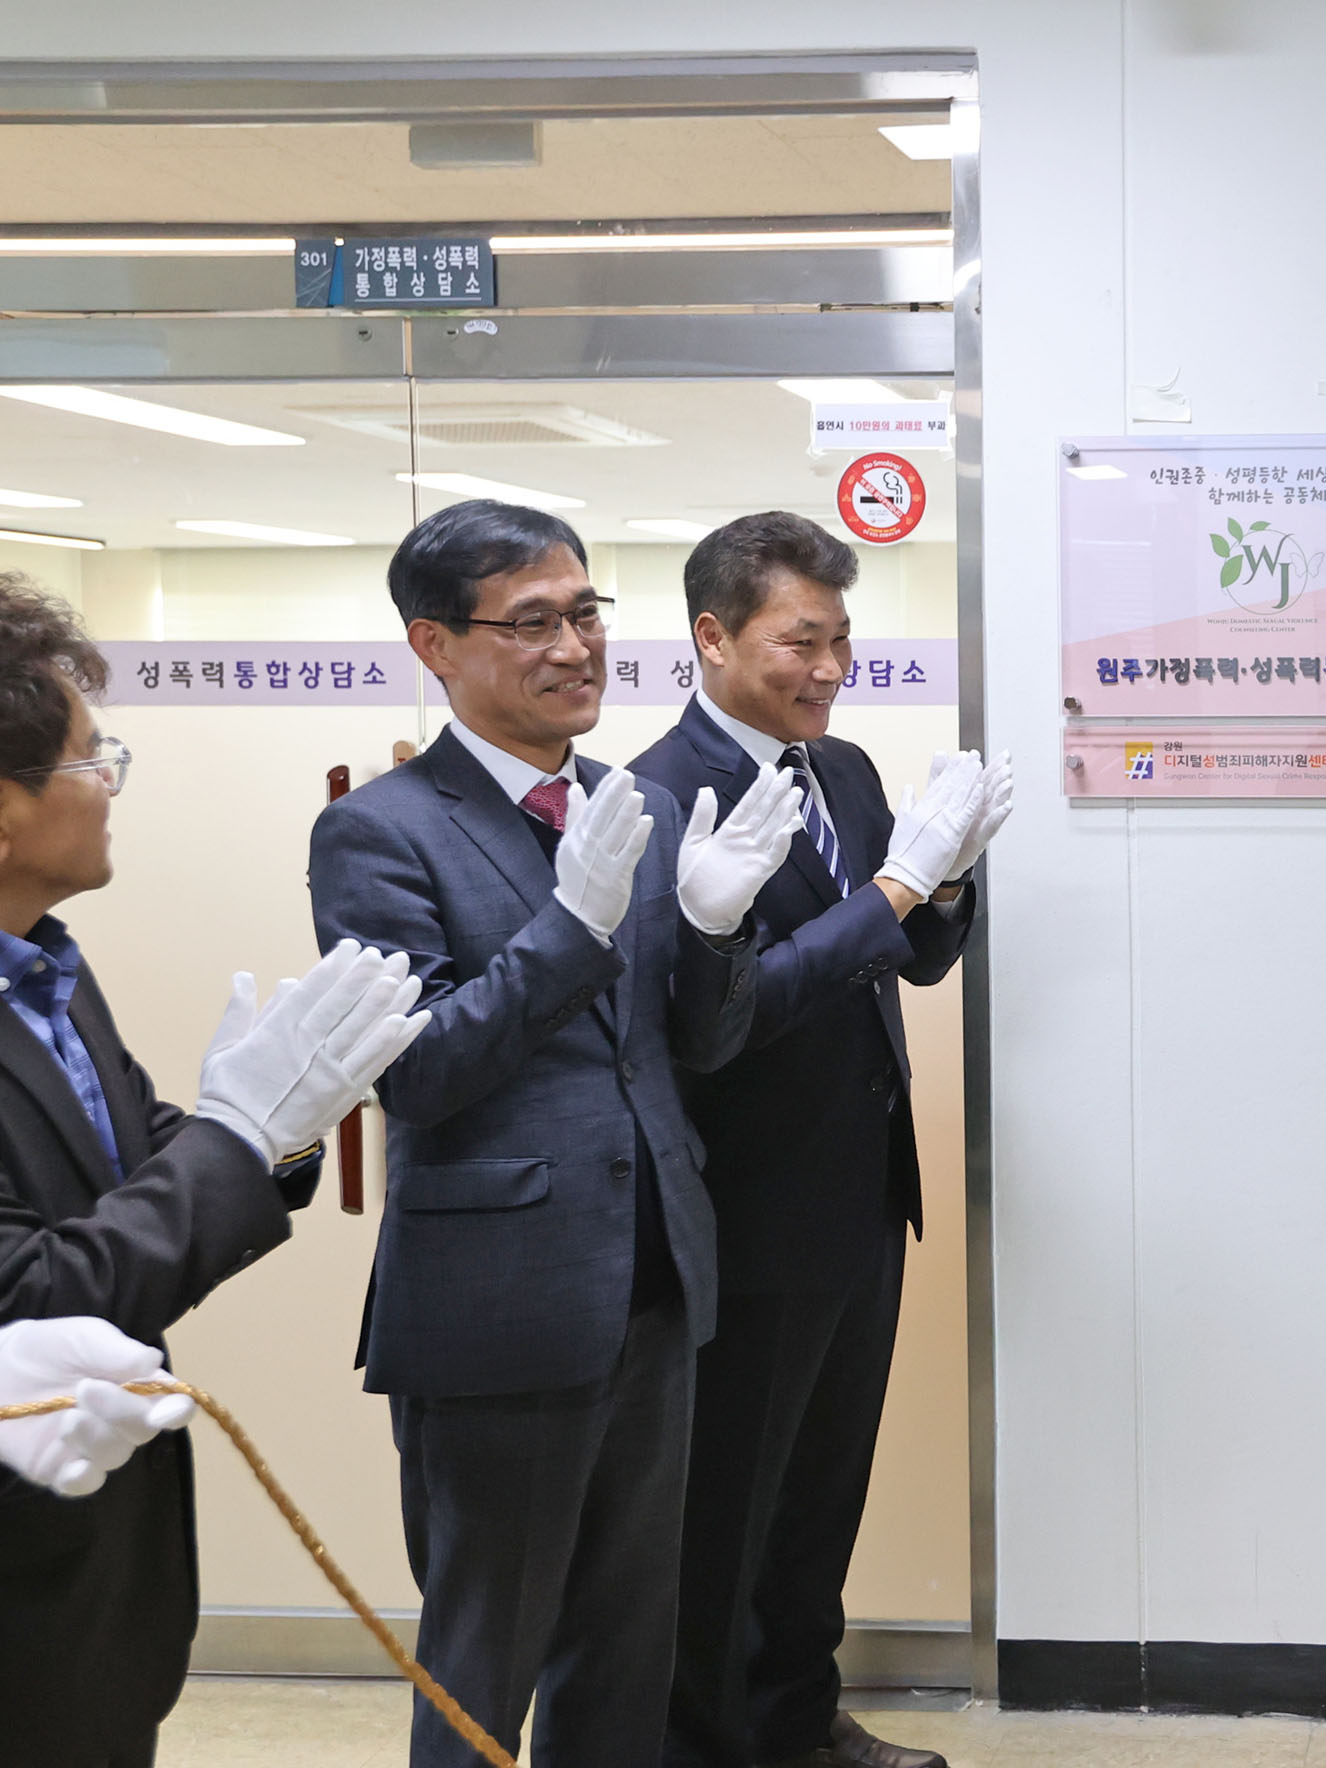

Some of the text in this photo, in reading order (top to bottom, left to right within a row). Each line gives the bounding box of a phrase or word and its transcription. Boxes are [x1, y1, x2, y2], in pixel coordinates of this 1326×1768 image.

[300, 252, 327, 266] 301
[850, 420, 890, 432] 10만원의
[928, 420, 946, 431] 부과
[1150, 466, 1206, 485] 인권존중
[1225, 465, 1288, 484] 성평등한
[1208, 486, 1274, 505] 함께하는
[137, 660, 387, 689] 성폭력통합상담소
[1164, 742, 1183, 752] 강원
